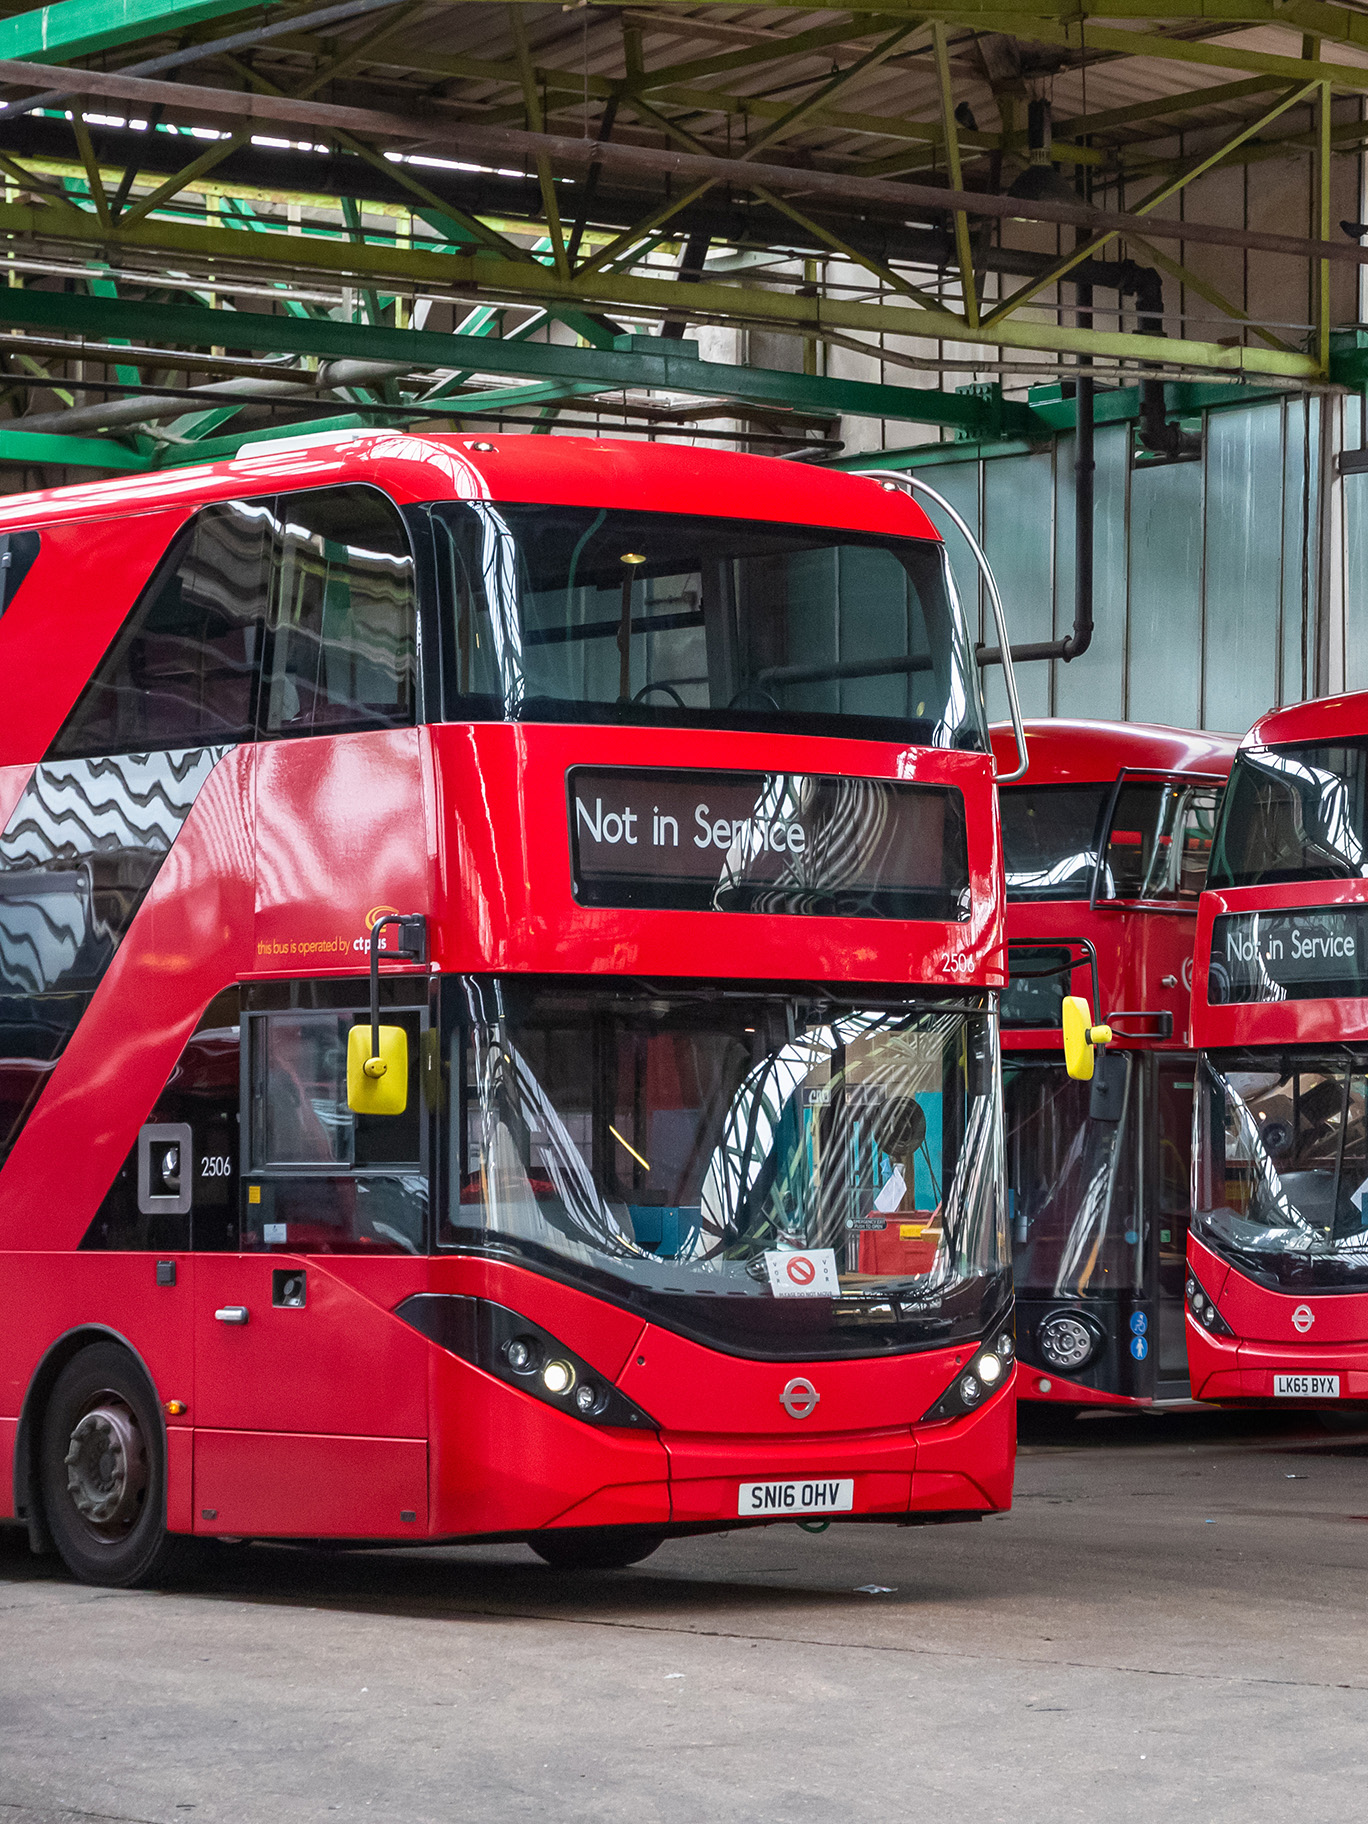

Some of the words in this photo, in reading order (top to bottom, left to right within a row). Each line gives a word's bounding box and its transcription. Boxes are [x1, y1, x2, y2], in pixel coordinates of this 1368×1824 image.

[575, 796, 637, 844] Not
[653, 805, 679, 846] in
[694, 804, 805, 853] Service
[257, 940, 272, 954] this
[273, 938, 289, 954] bus
[290, 939, 297, 953] is
[298, 935, 338, 957] operated
[339, 936, 350, 956] by
[1227, 932, 1261, 961] Not
[1269, 934, 1283, 959] in
[1291, 929, 1355, 959] Service
[941, 953, 975, 973] 2506
[201, 1156, 231, 1177] 2506
[1279, 1377, 1308, 1393] LK65
[1311, 1377, 1334, 1393] BYX
[751, 1485, 795, 1509] SN16
[802, 1483, 840, 1506] OHV
